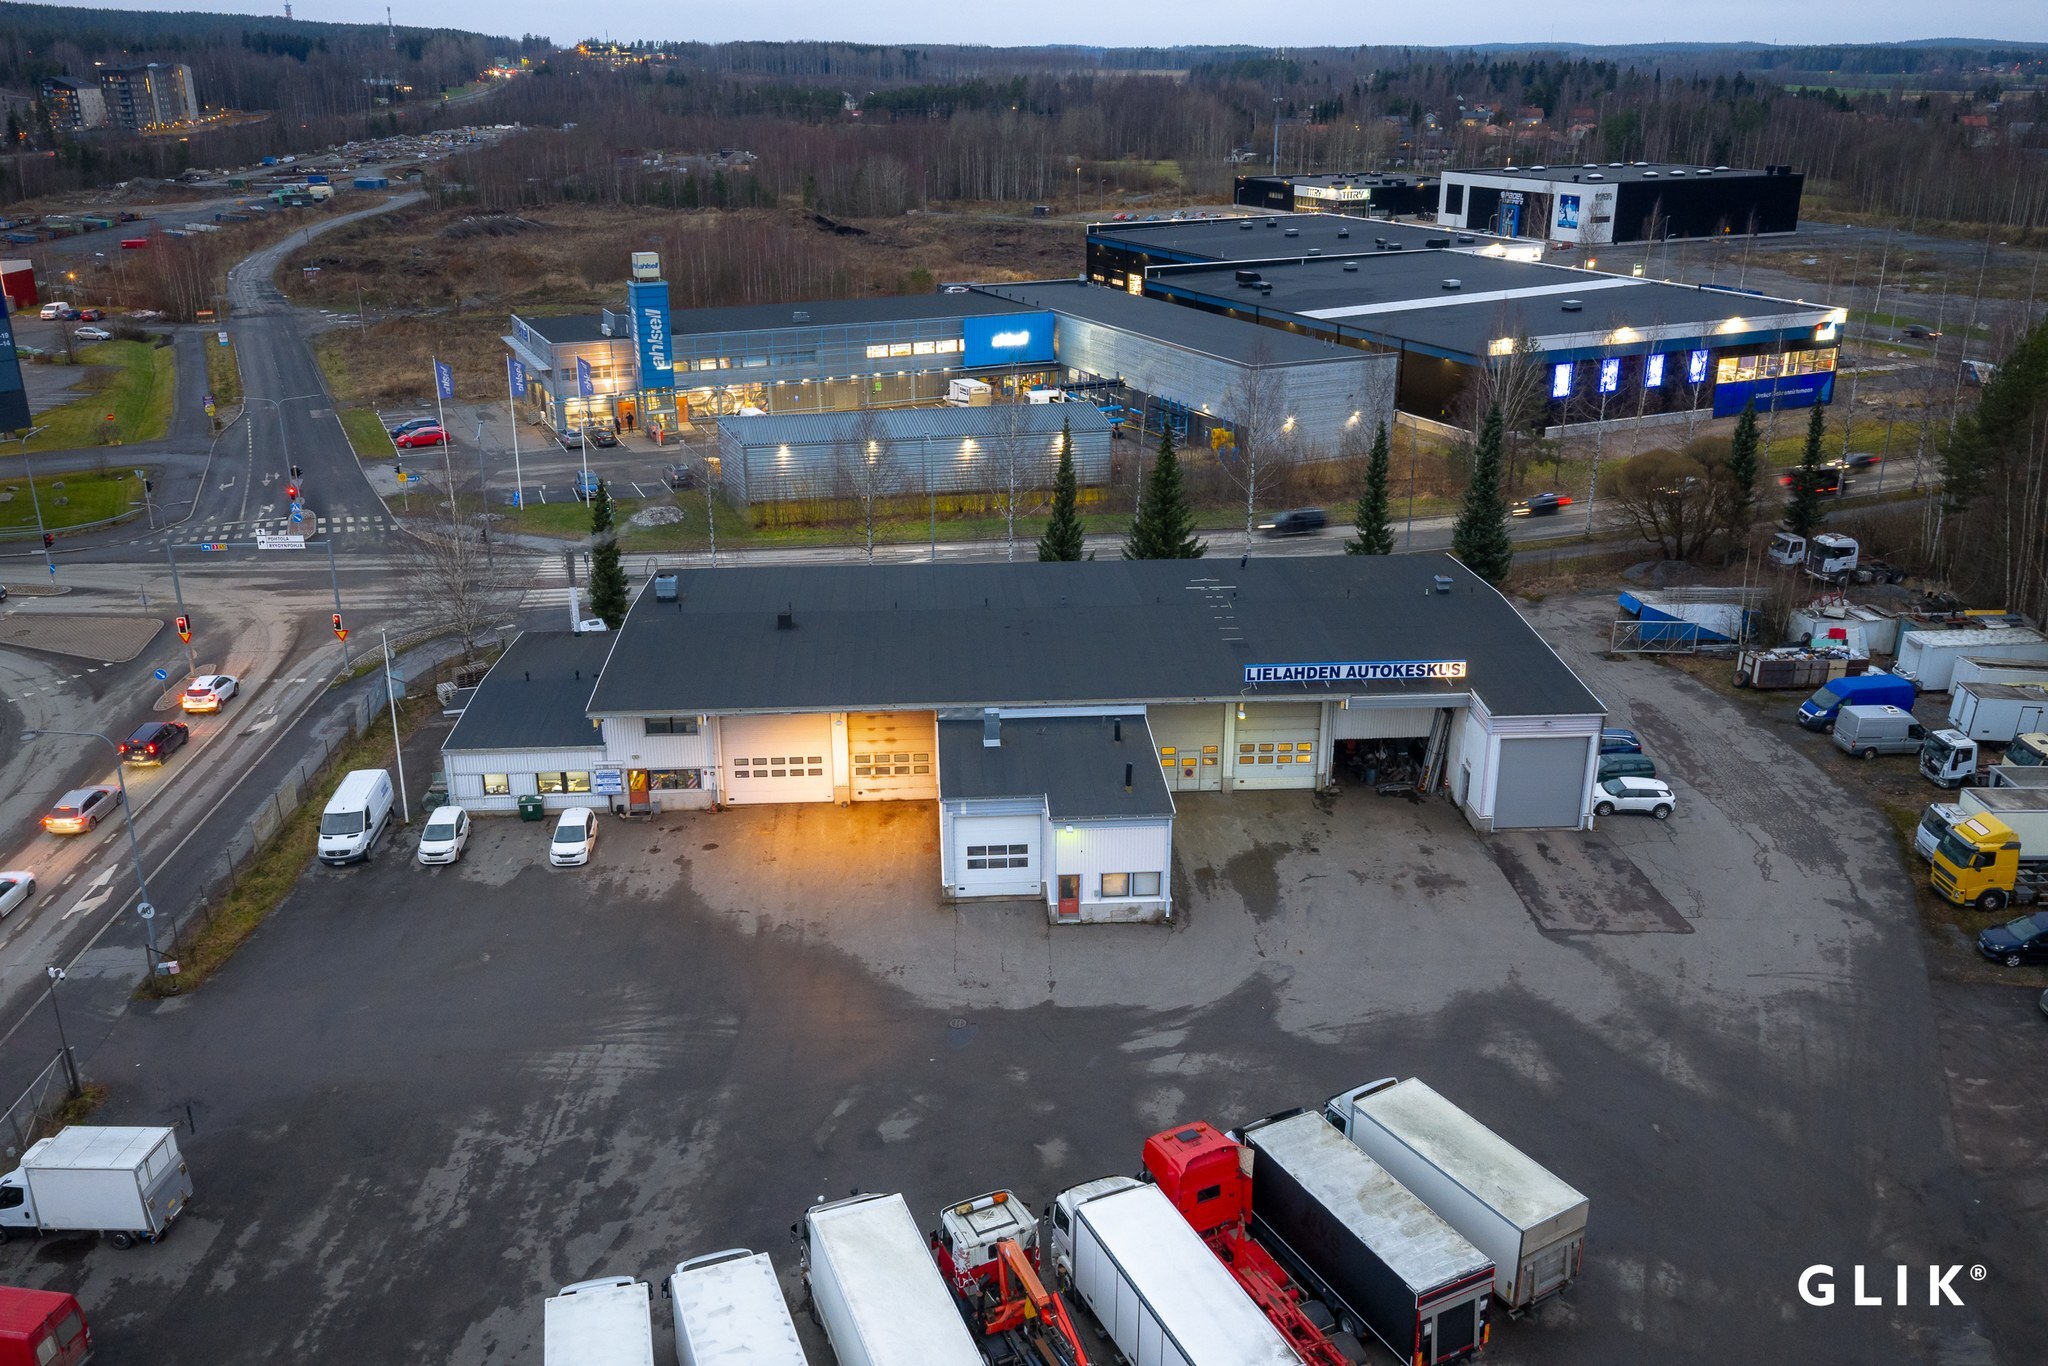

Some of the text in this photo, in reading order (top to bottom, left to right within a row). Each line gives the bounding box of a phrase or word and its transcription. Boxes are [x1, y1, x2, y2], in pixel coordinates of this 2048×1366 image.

[645, 308, 672, 370] ahlsell
[1246, 665, 1341, 681] LIELAHDEN
[1345, 663, 1461, 678] AUTOKESKUS
